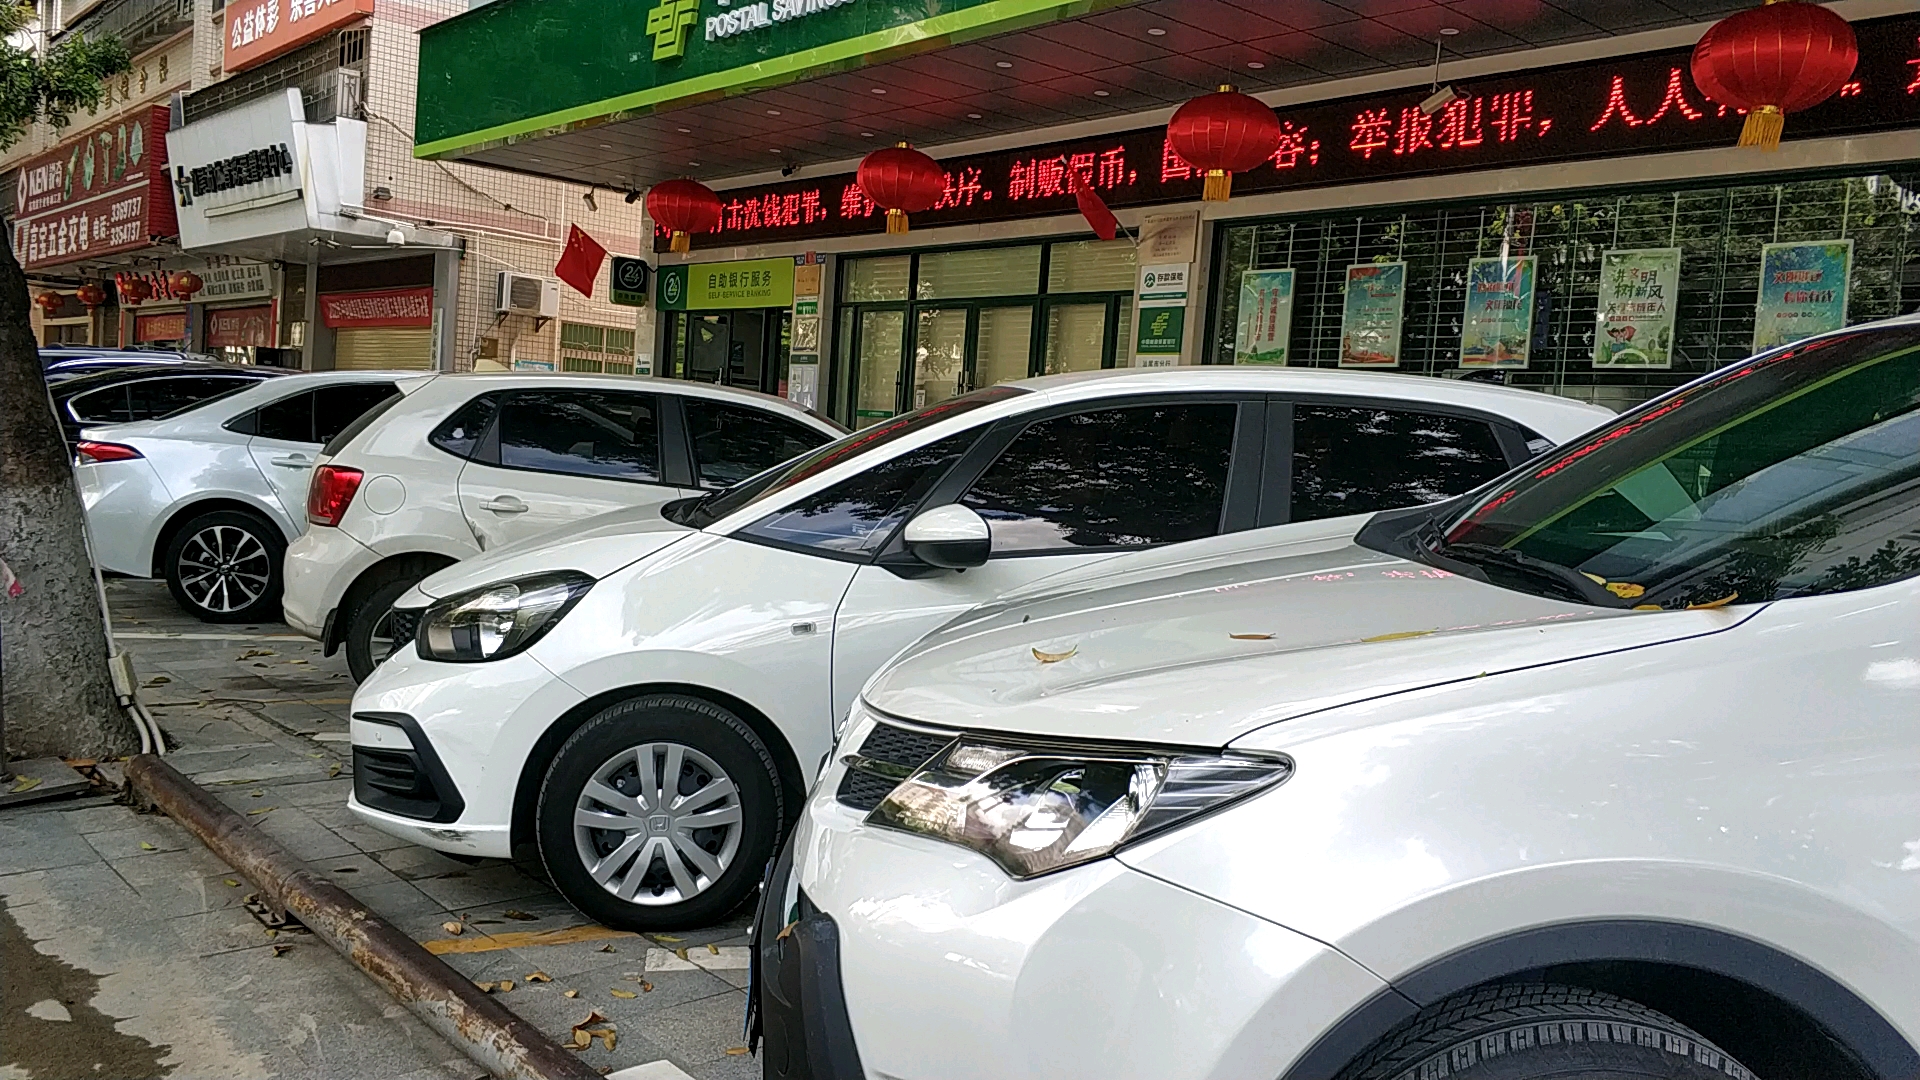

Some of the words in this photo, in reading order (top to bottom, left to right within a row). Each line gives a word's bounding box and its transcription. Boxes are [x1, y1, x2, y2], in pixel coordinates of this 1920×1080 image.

[232, 0, 279, 49] 公益体彩
[705, 1, 772, 42] POSTAL
[772, 0, 856, 22] SAVIN
[708, 270, 772, 289] 自助银行服务
[1156, 272, 1184, 283] 存款保险
[1612, 267, 1658, 285] 讲文明
[746, 288, 772, 298] BANKING
[1613, 279, 1665, 300] 树新风
